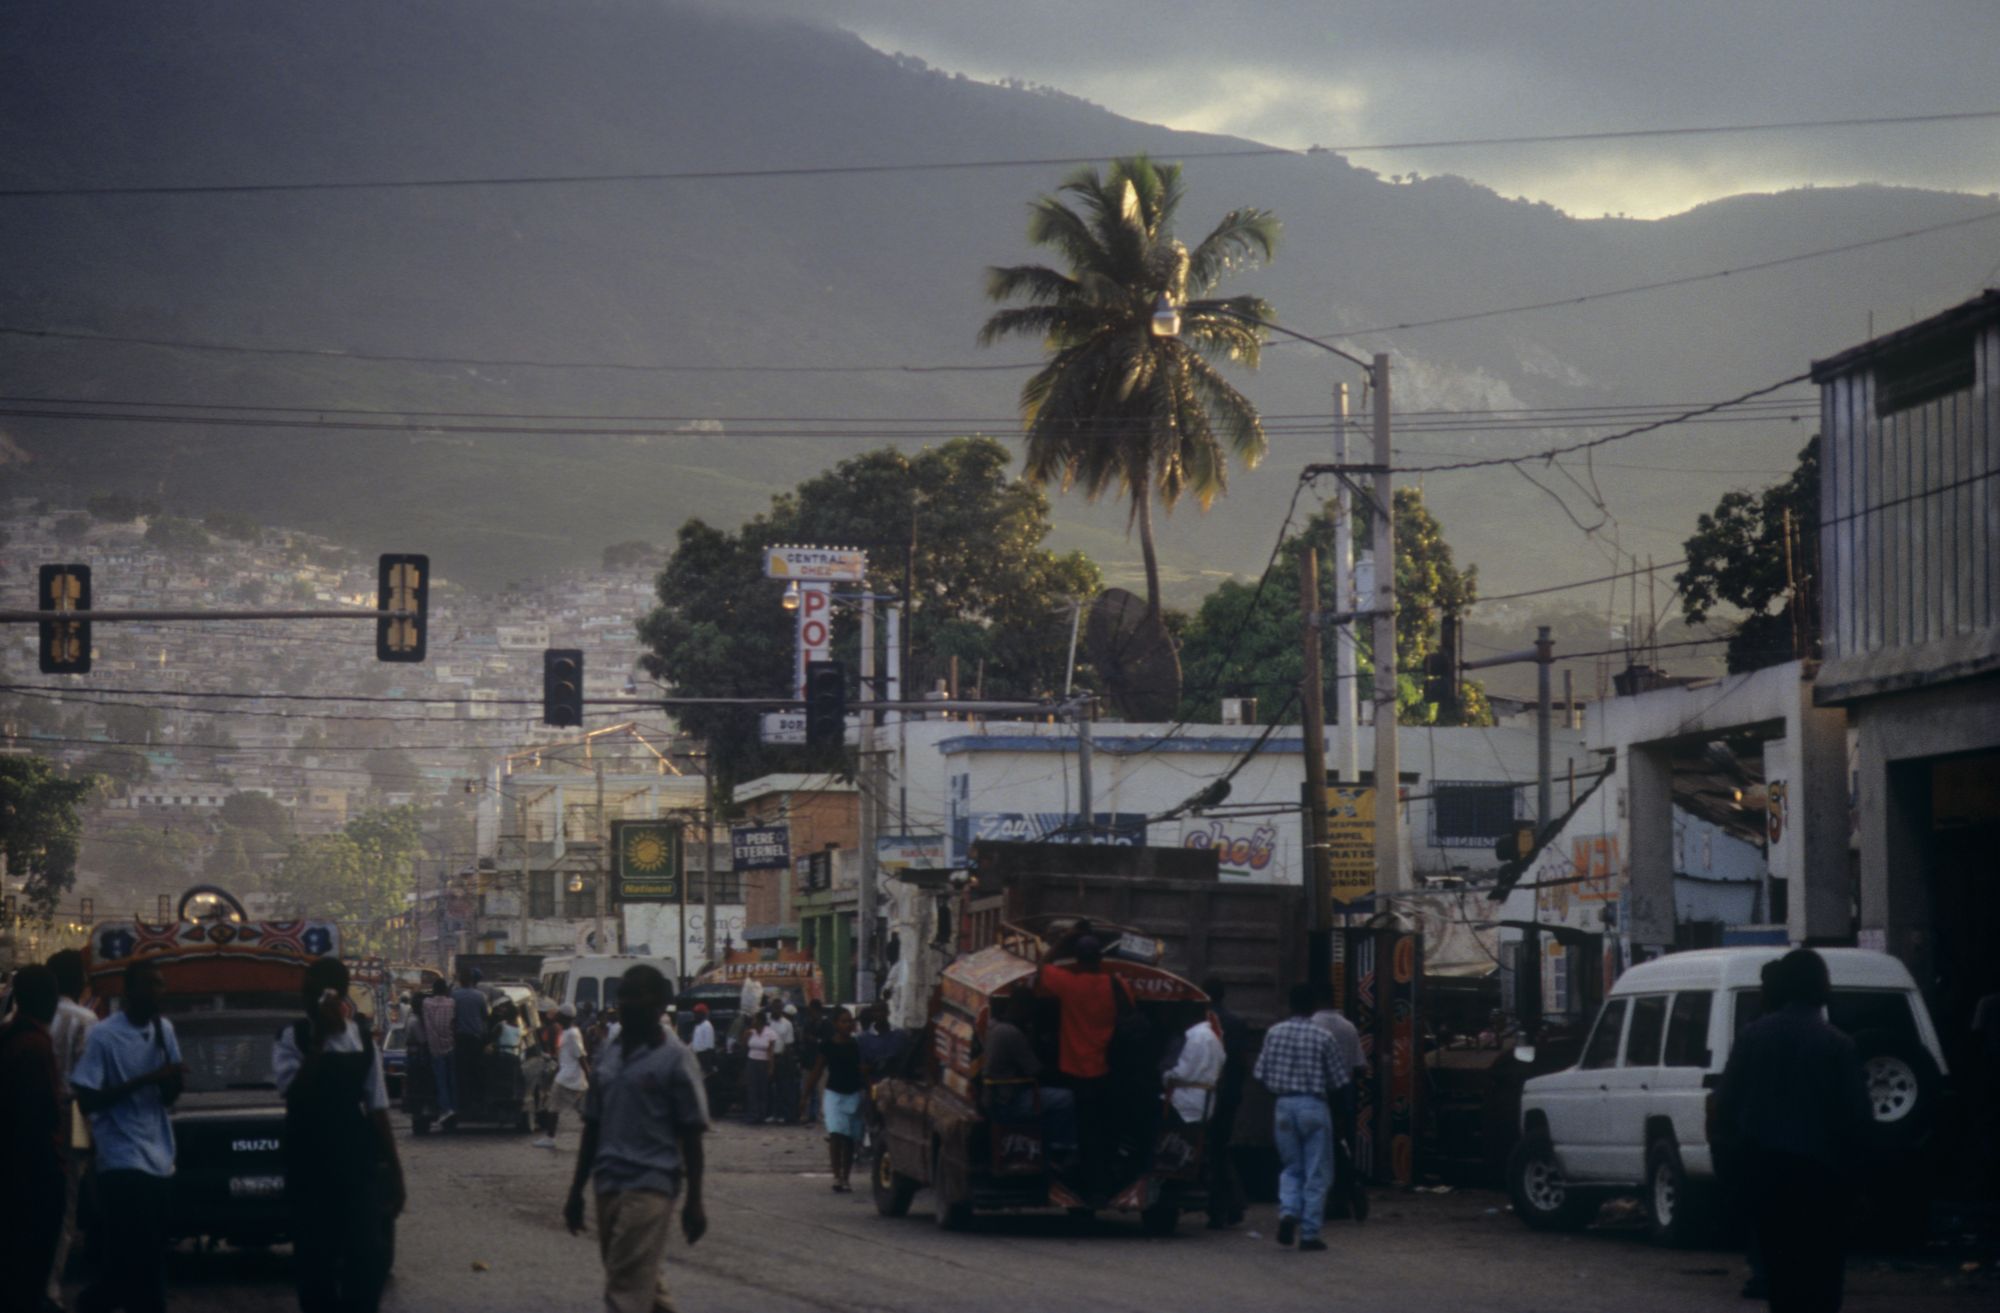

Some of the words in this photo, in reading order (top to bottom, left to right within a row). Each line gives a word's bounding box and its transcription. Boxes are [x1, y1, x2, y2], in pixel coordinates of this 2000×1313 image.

[746, 833, 775, 845] PERE
[735, 845, 787, 859] ETERNEL
[624, 884, 672, 894] National
[232, 1139, 280, 1151] ISUZU
